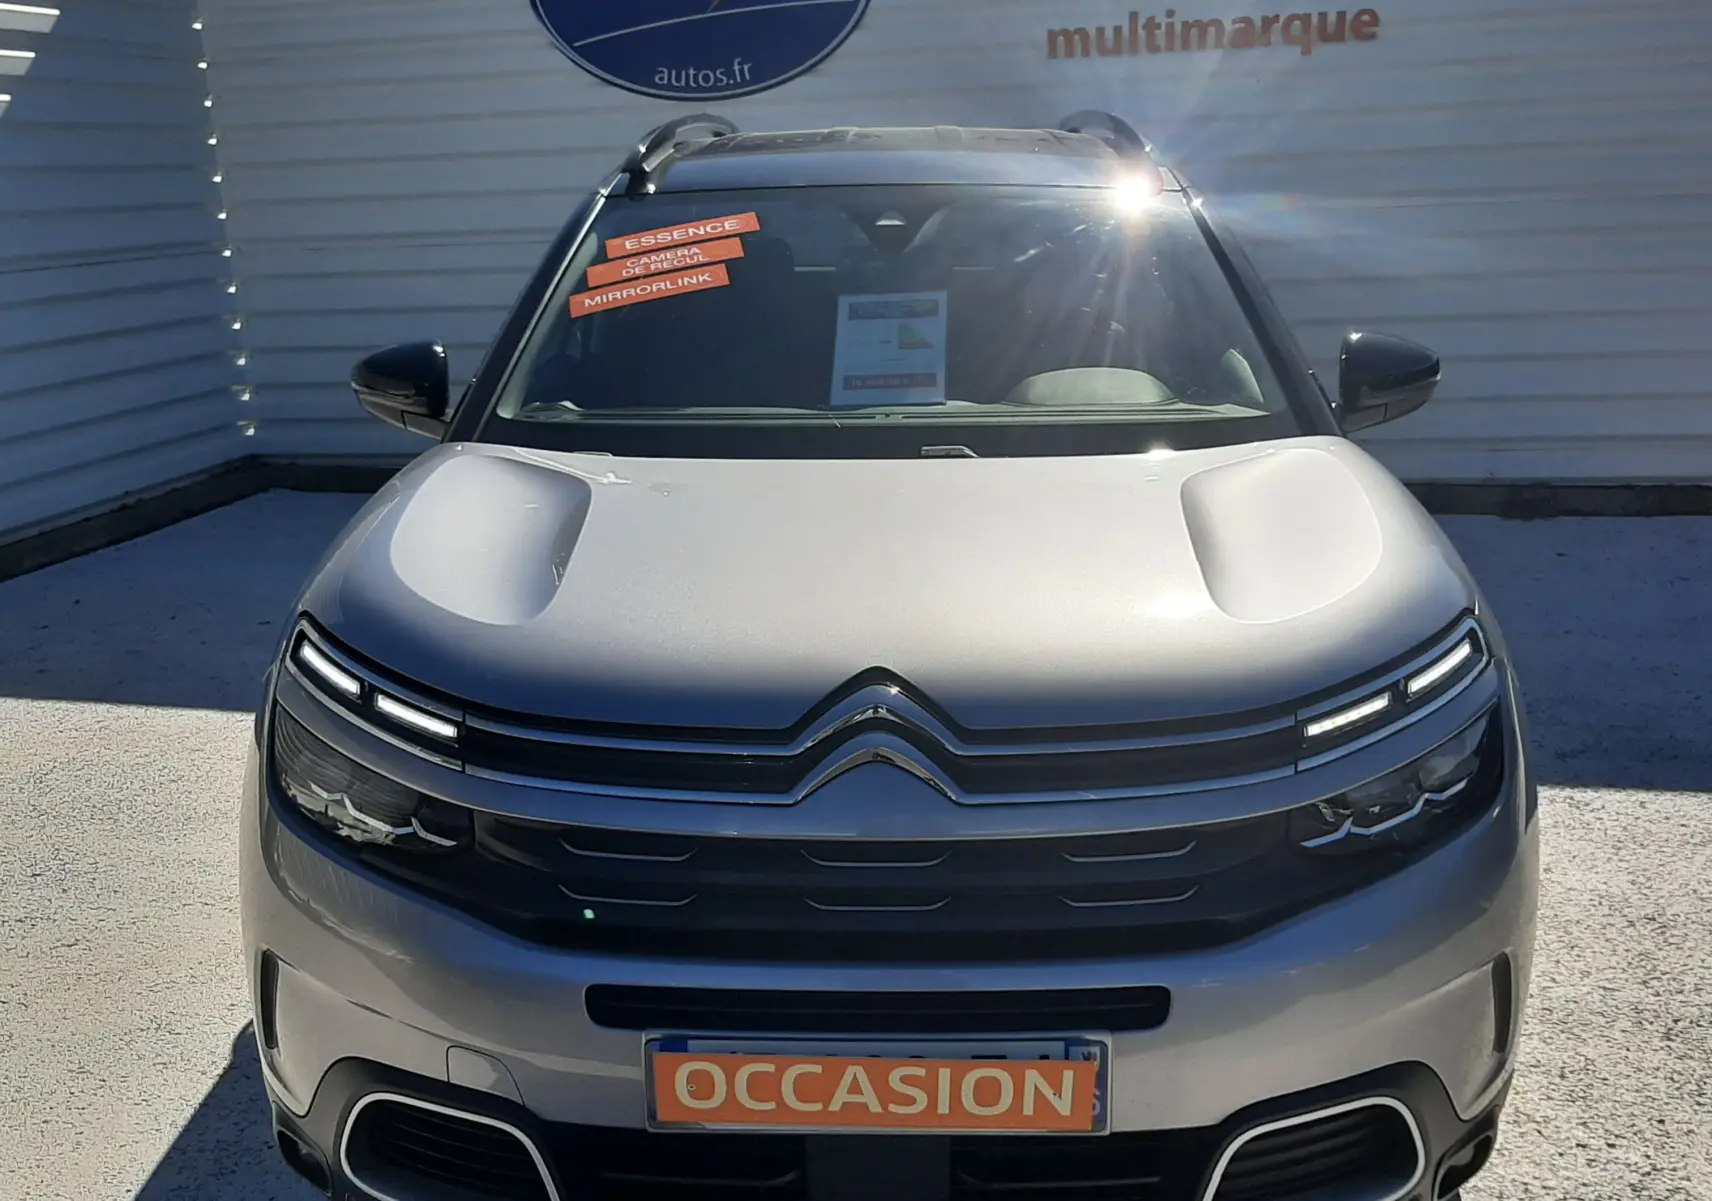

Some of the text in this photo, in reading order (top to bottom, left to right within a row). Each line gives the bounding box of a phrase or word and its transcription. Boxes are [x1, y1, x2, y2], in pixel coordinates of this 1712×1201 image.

[1047, 7, 1380, 58] multimarque
[654, 58, 752, 87] autos.fr
[624, 219, 740, 250] ESSENCE
[621, 254, 711, 277] DE RECUL
[626, 247, 702, 267] CAMERA
[584, 272, 713, 307] MIRRORLINK
[674, 1060, 1075, 1117] OCCASION
